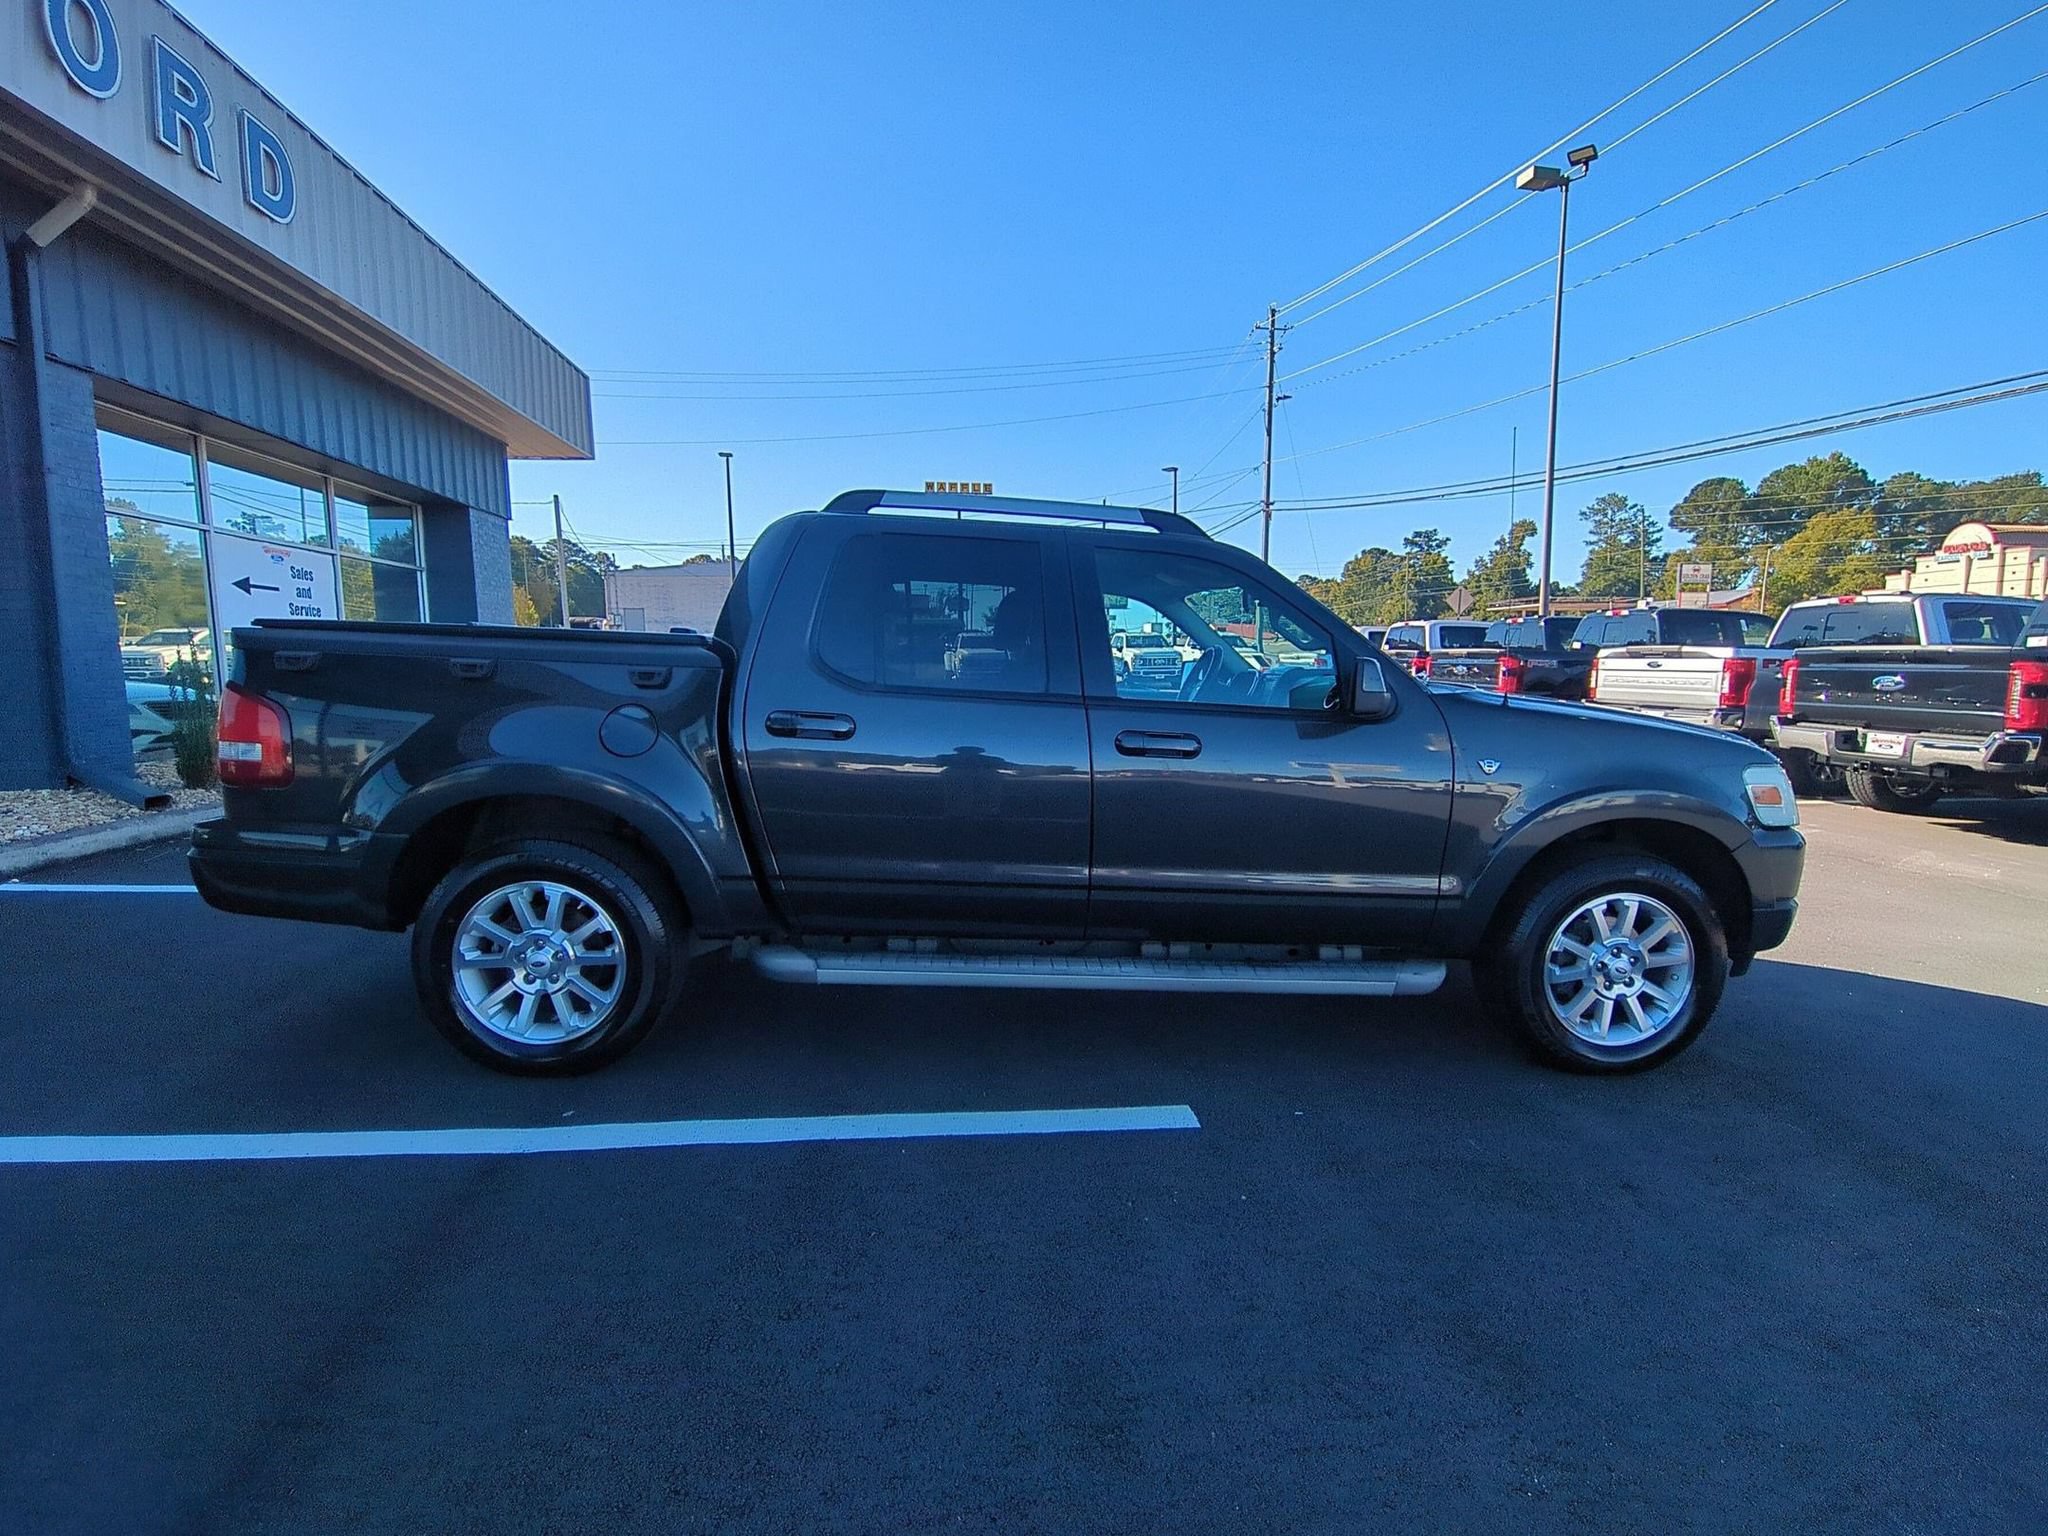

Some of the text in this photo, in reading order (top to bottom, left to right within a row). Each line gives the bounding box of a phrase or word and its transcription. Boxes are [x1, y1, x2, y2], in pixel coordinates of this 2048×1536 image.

[926, 482, 992, 493] WAFFLE
[290, 565, 314, 582] Sales
[296, 586, 312, 600] and
[288, 602, 321, 618] Service
